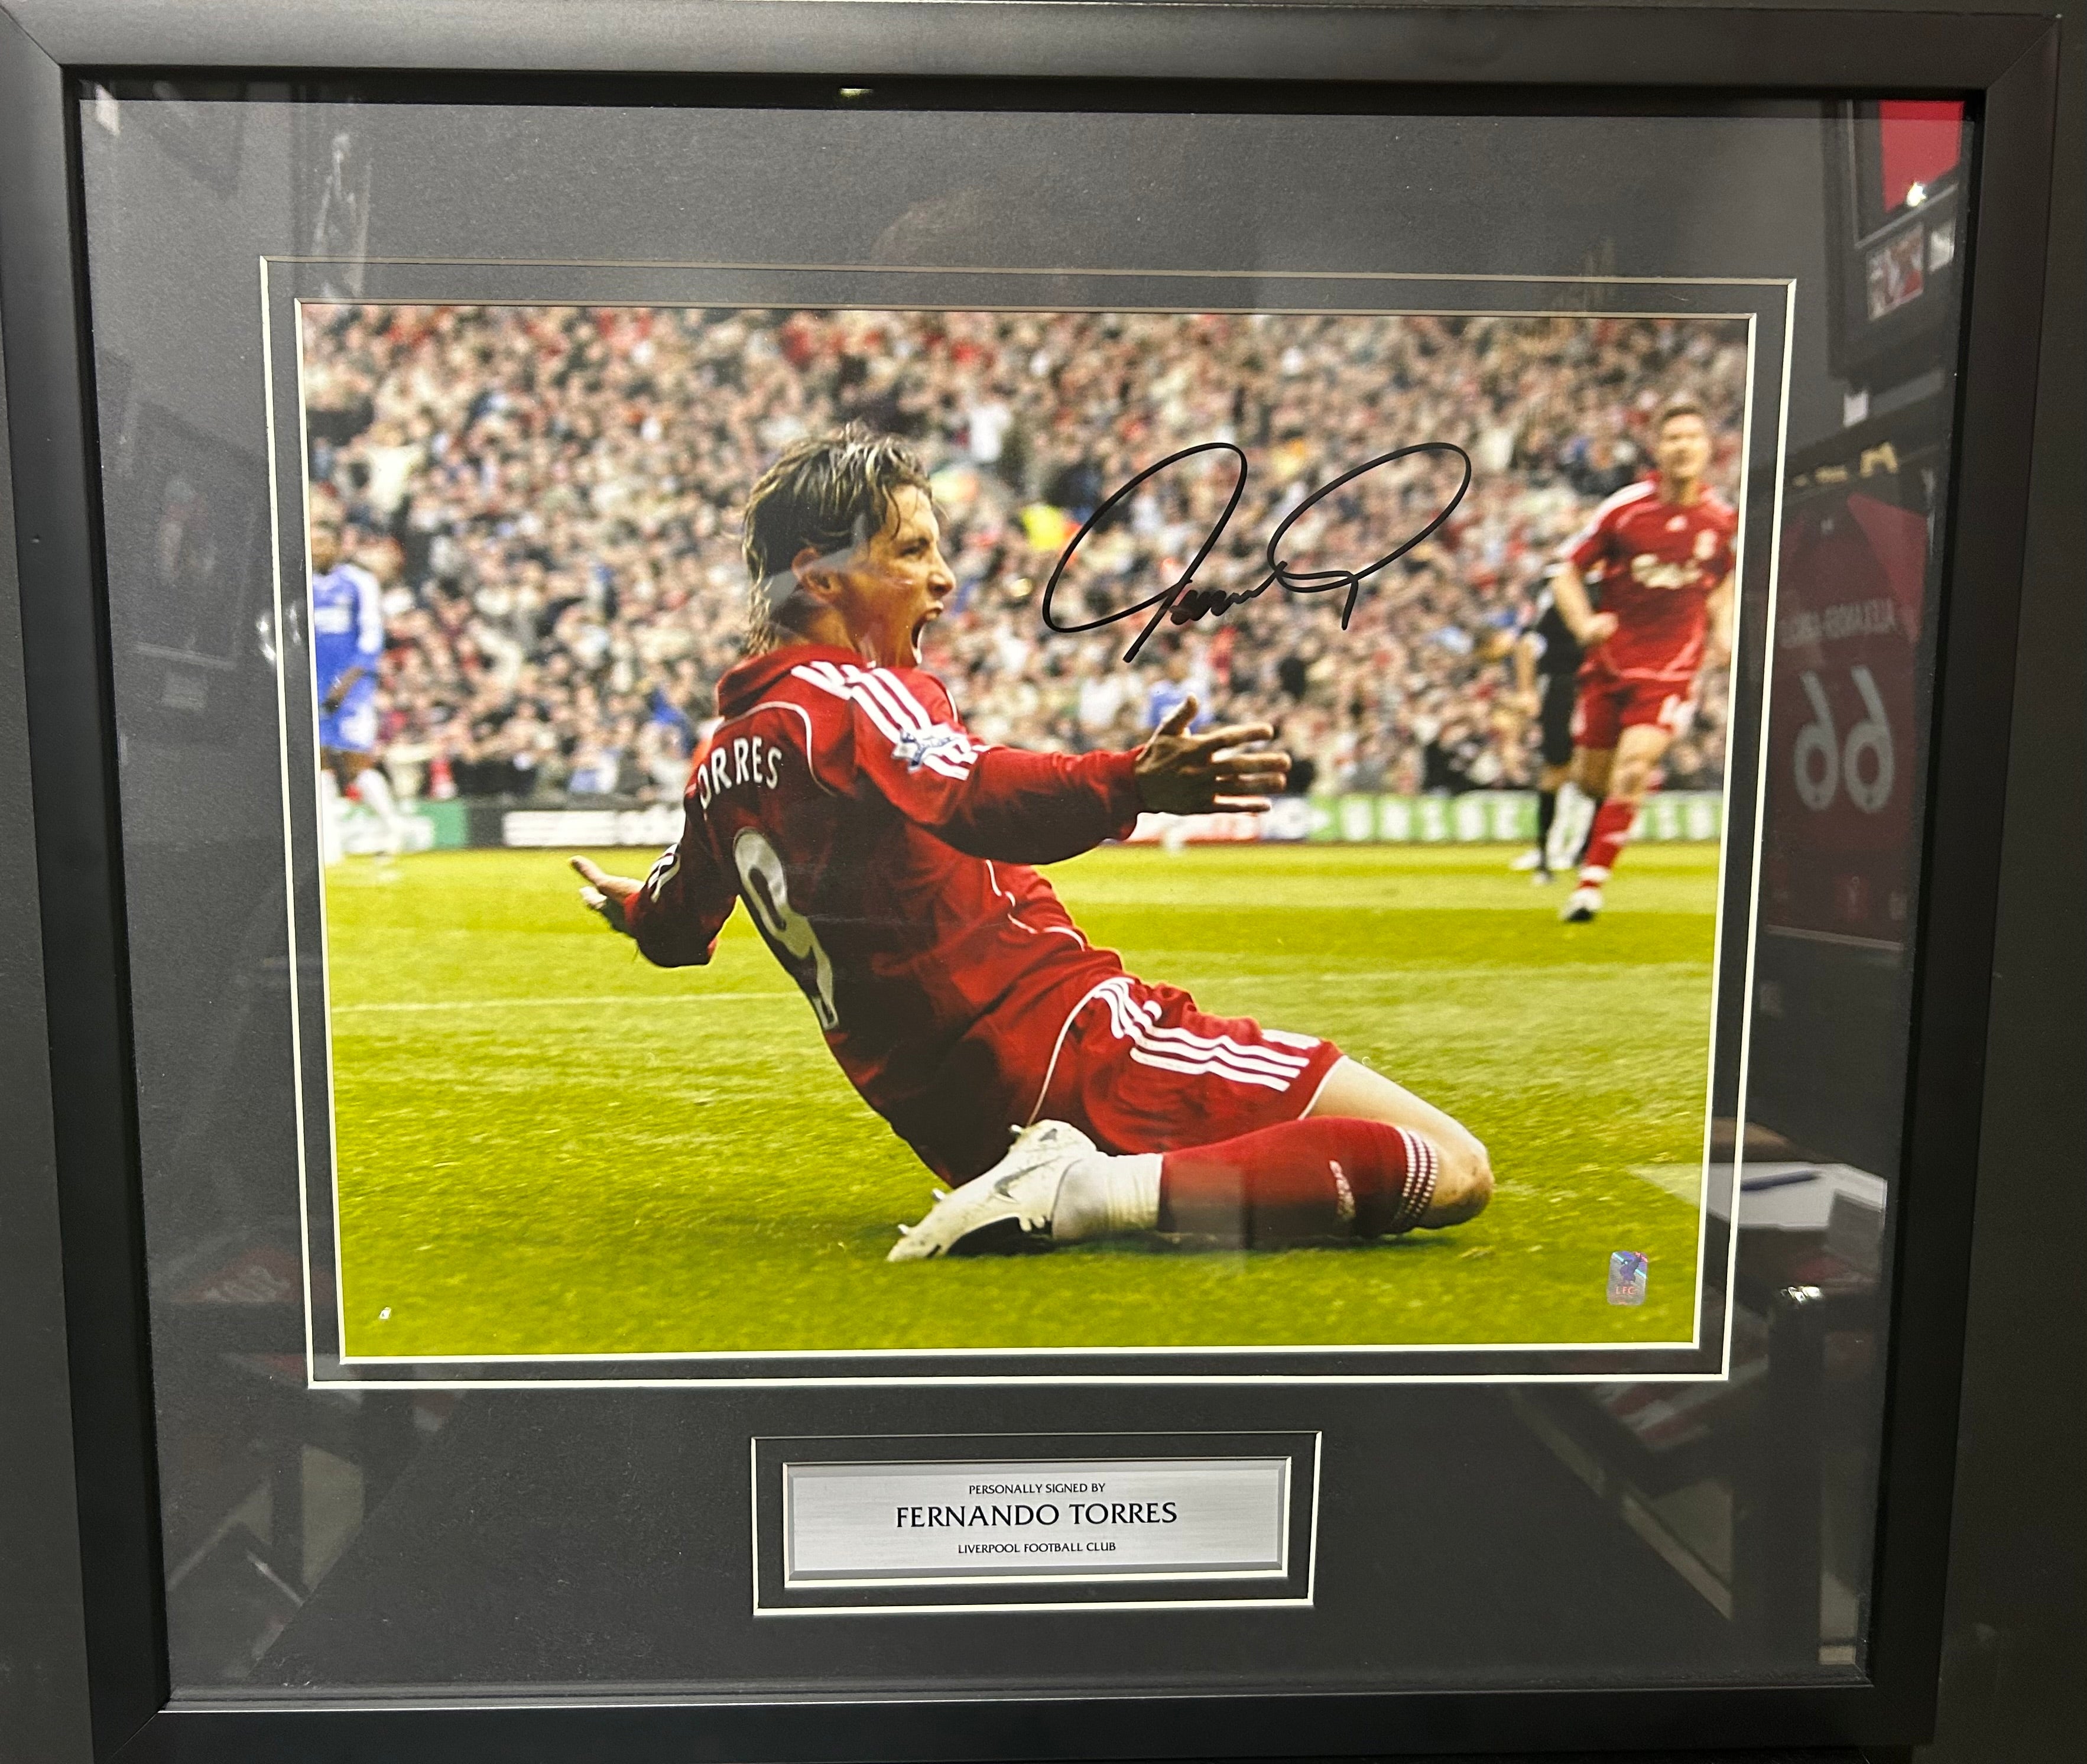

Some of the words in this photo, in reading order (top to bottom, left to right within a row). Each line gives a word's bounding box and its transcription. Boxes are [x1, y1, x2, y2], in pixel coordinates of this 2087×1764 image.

[697, 736, 783, 810] ORRES
[1615, 1286, 1635, 1295] LFC
[969, 1483, 1043, 1495] PERSONALLY
[1046, 1483, 1088, 1493] SIGNED
[1092, 1482, 1105, 1492] BY
[896, 1504, 1059, 1528] FERNANDO
[1069, 1502, 1177, 1525] TORRES
[958, 1543, 1020, 1554] LIVERPOOL
[1024, 1542, 1083, 1553] FOOTBALL
[1086, 1542, 1116, 1552] CLUB
